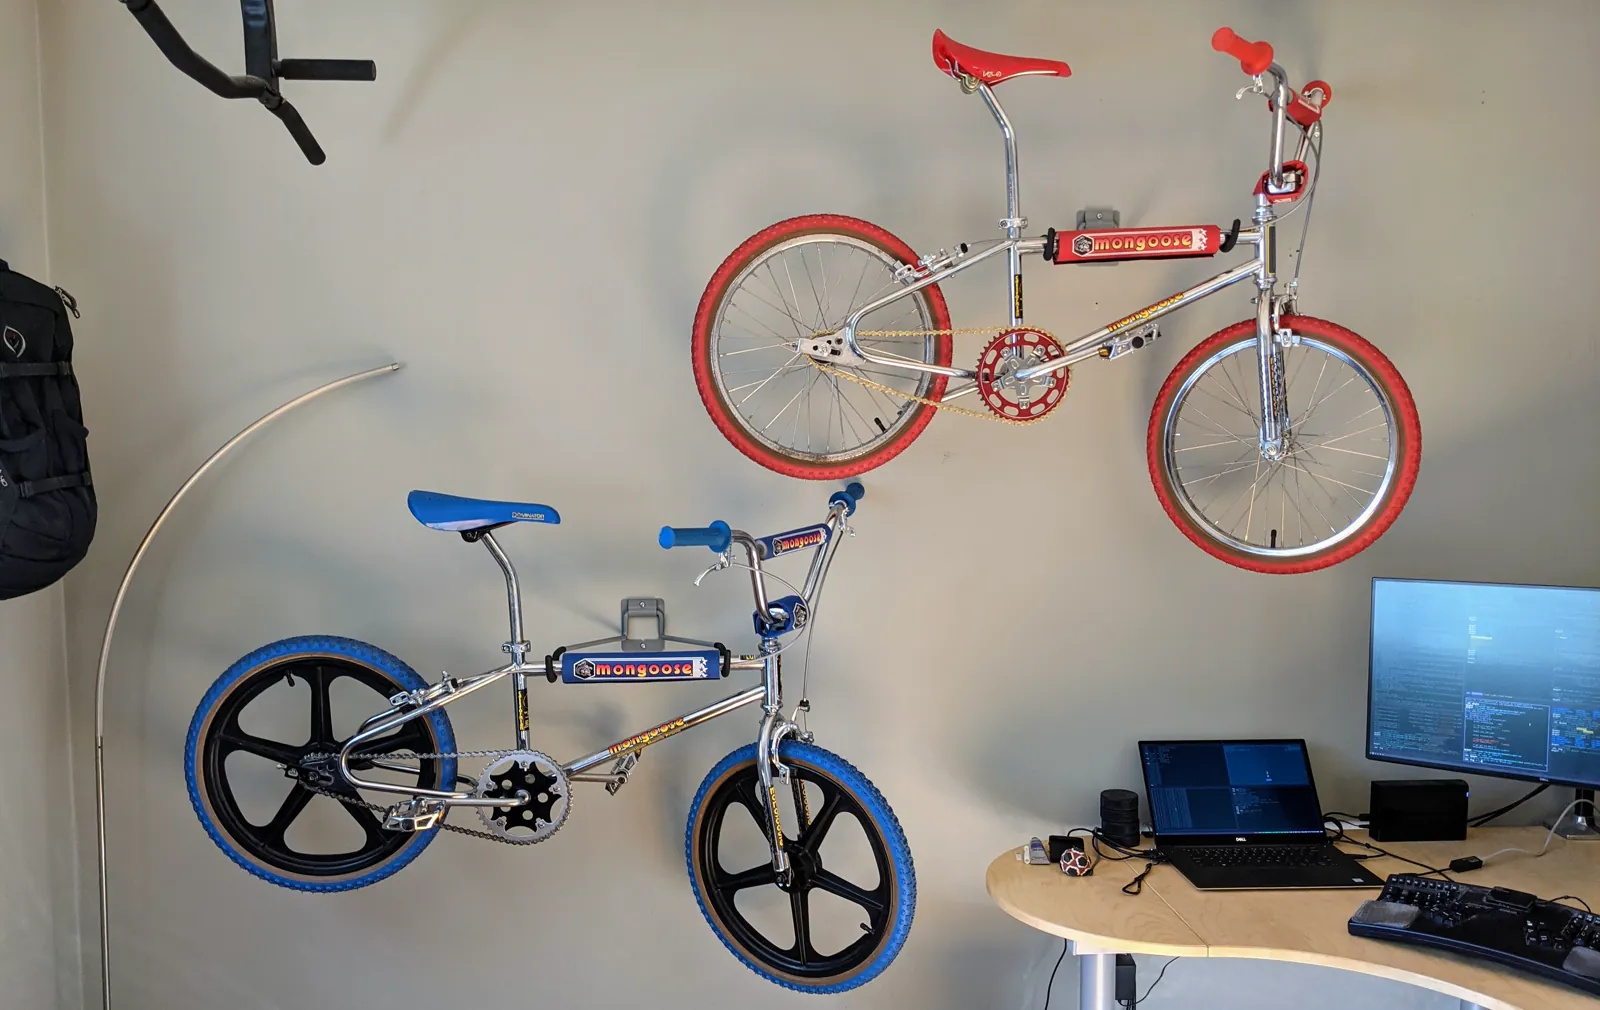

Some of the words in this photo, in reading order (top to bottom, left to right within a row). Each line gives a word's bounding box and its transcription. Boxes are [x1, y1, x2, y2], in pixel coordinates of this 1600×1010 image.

[1094, 233, 1192, 251] mongoose
[1107, 291, 1184, 332] mongoose
[782, 532, 822, 548] mongoose
[596, 663, 693, 678] mongoose
[608, 717, 685, 754] mongoose
